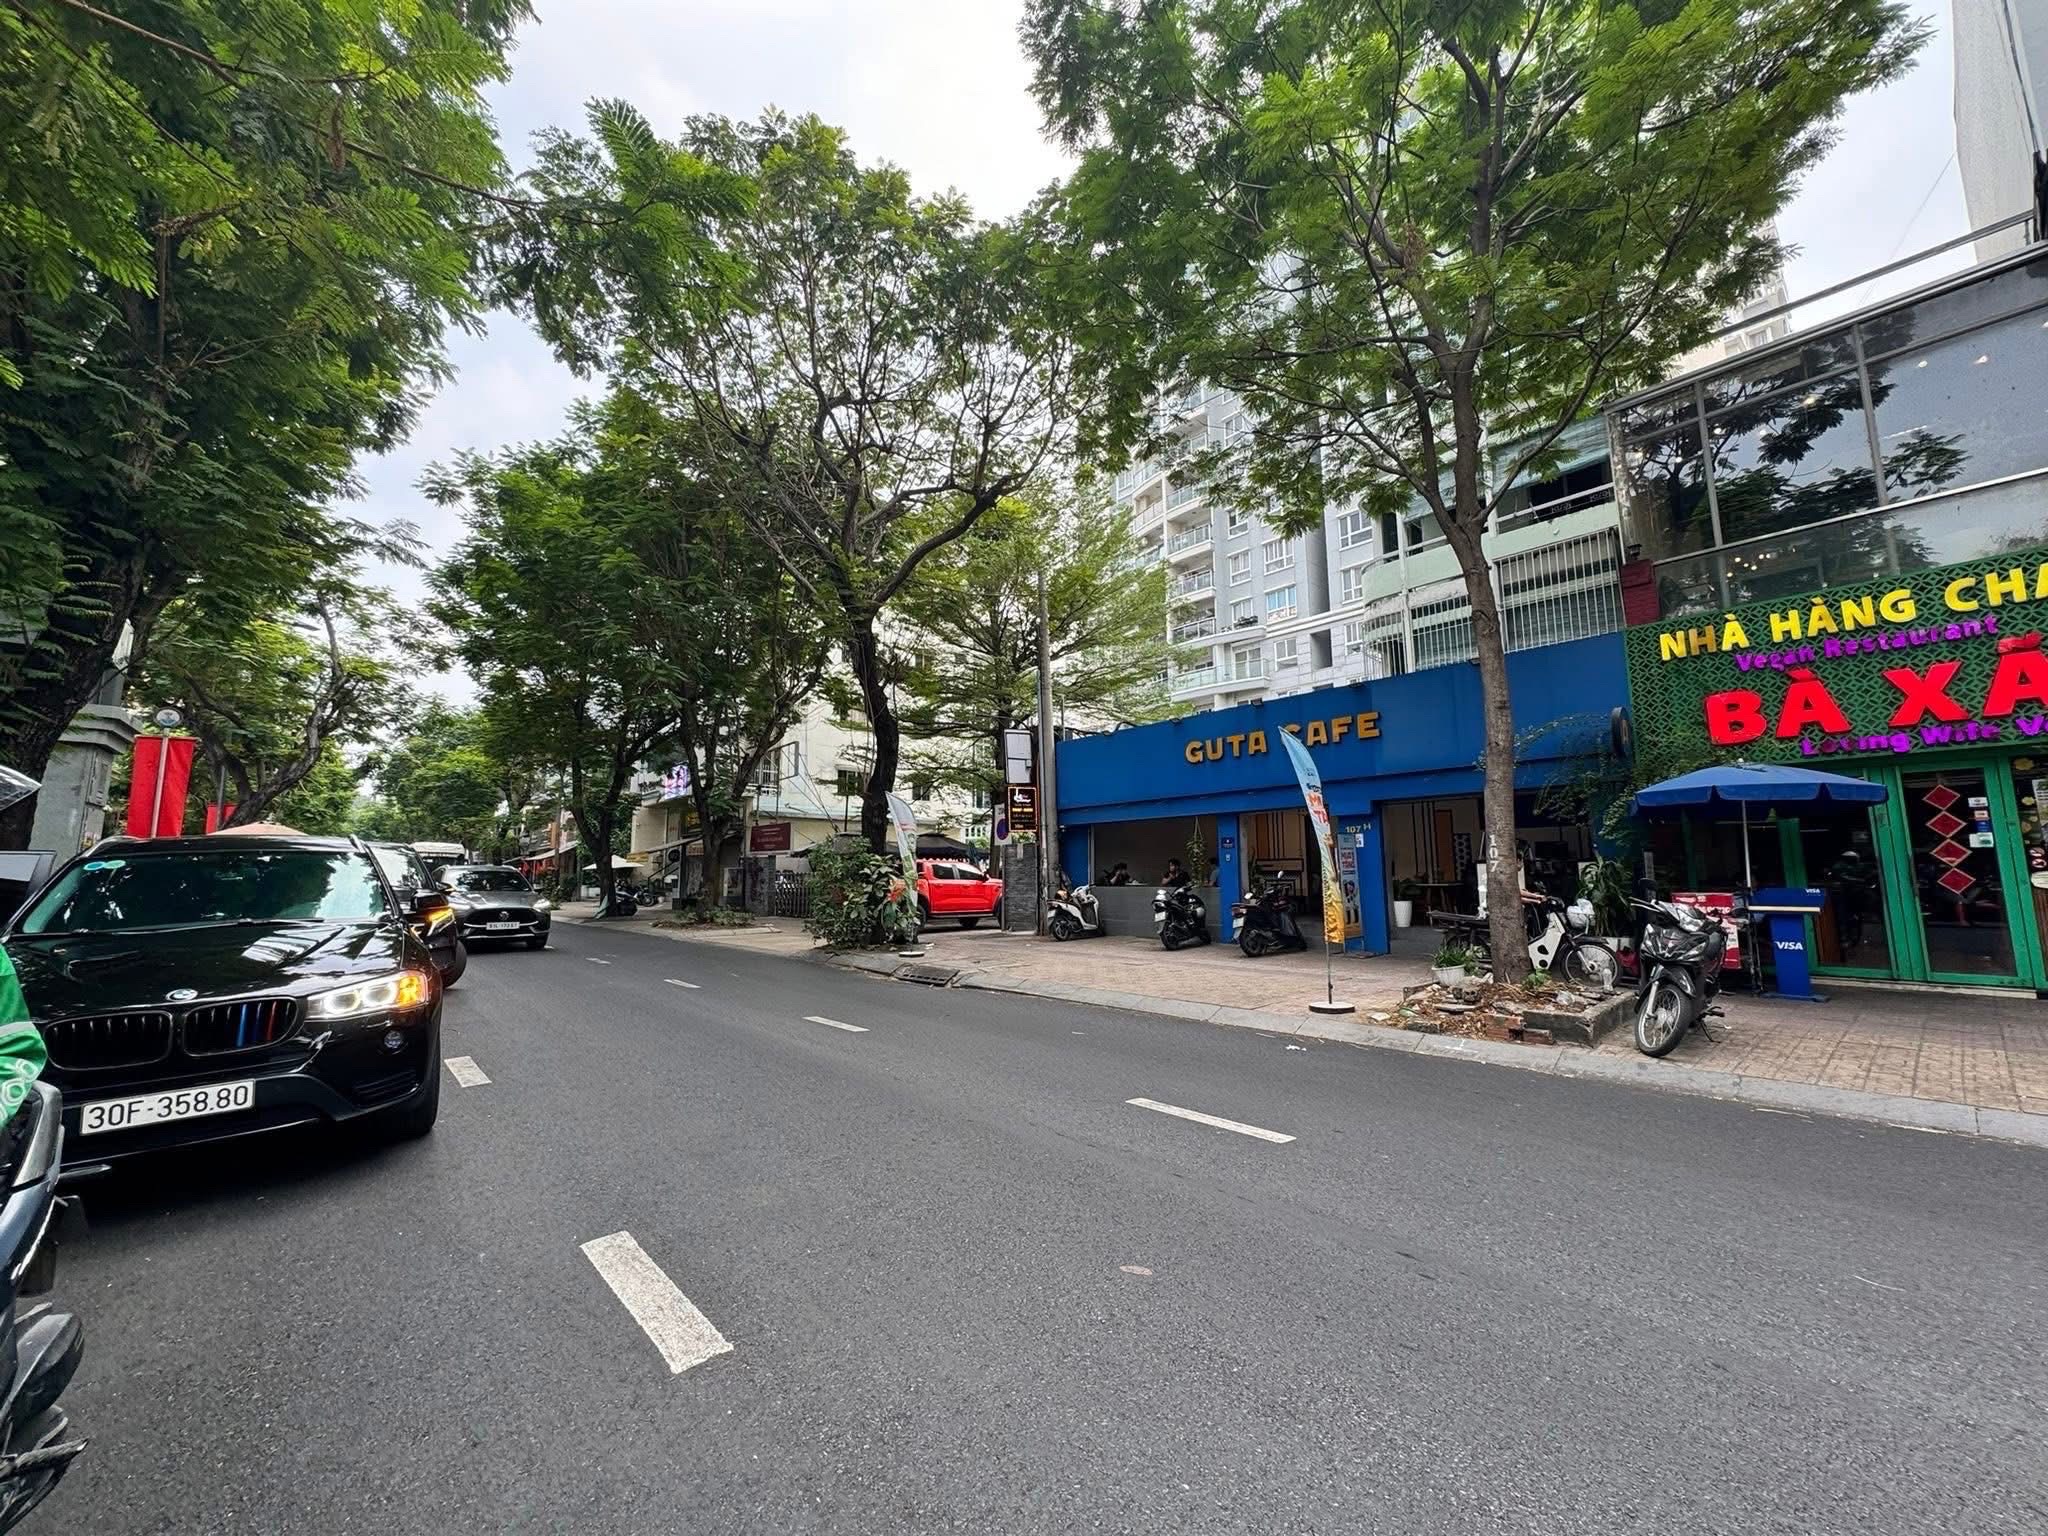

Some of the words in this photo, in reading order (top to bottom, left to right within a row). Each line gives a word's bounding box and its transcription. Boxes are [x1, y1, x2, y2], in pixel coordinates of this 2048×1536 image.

[1659, 613, 1750, 661] NHÀ
[1769, 589, 1917, 643] HÀNG
[1735, 644, 1816, 672] Vegan
[1823, 614, 2000, 659] Restaurant
[1704, 667, 1852, 748] BÀ
[1882, 631, 2048, 729] XÃ
[1185, 730, 1268, 764] GUTA
[2015, 715, 2048, 737] V
[1489, 834, 1500, 873] 107
[1775, 940, 1804, 951] VISA
[87, 1085, 249, 1130] 30F-358.80
